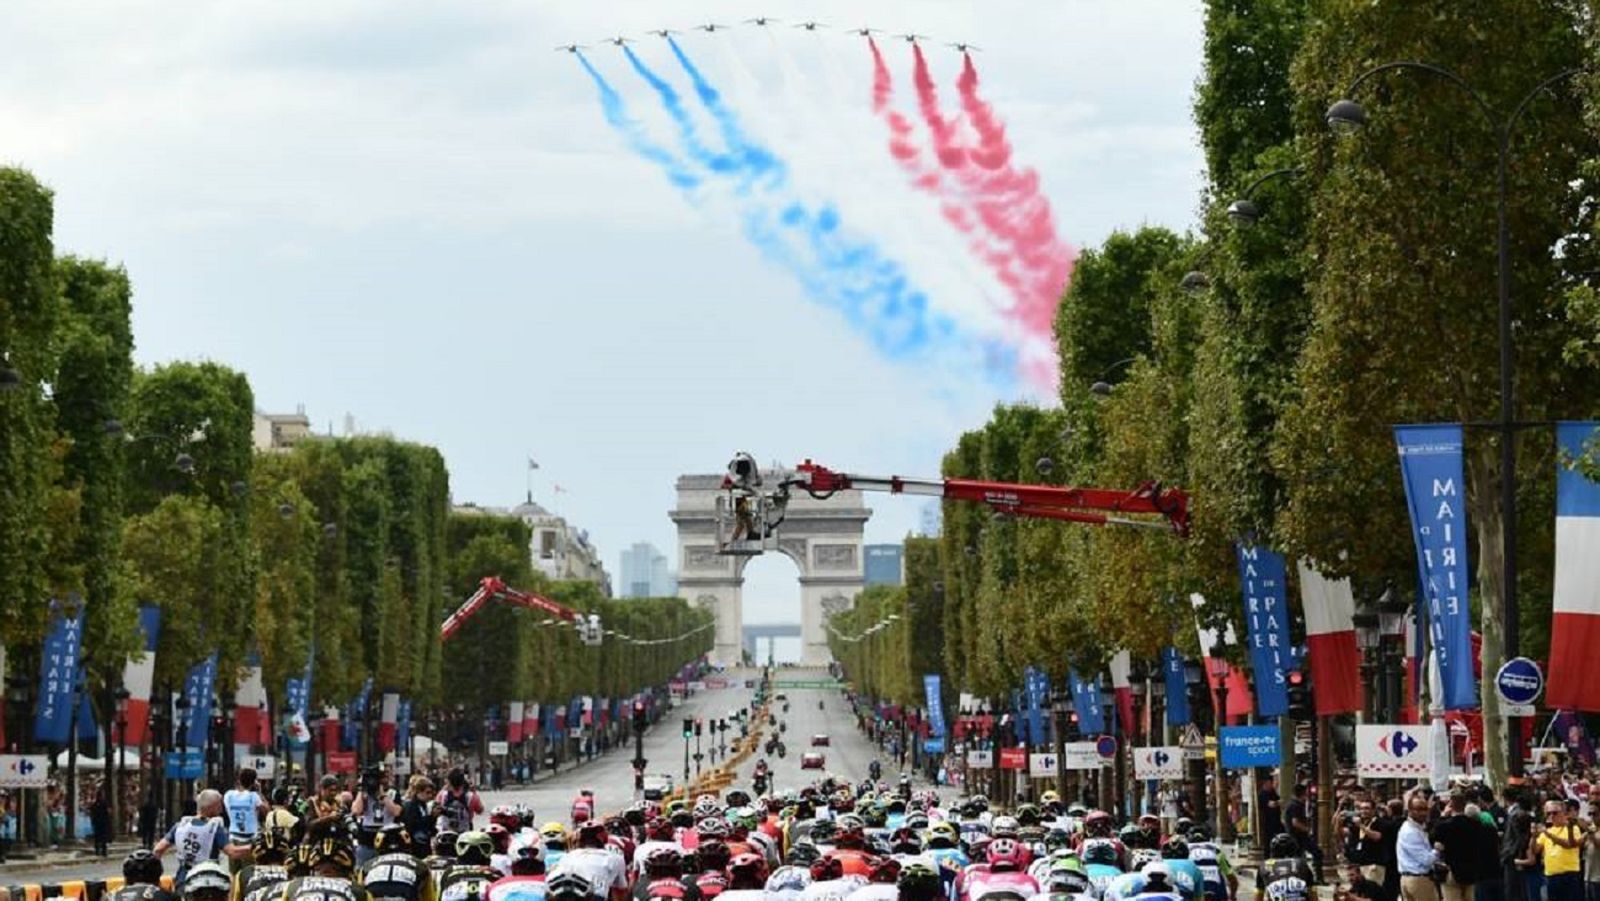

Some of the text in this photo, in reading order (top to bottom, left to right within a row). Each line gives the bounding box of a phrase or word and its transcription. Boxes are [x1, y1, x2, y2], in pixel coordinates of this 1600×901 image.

[1241, 548, 1263, 648] MAIRIE
[1264, 597, 1286, 684] PARIS
[1247, 745, 1276, 758] sport
[183, 838, 201, 854] 29
